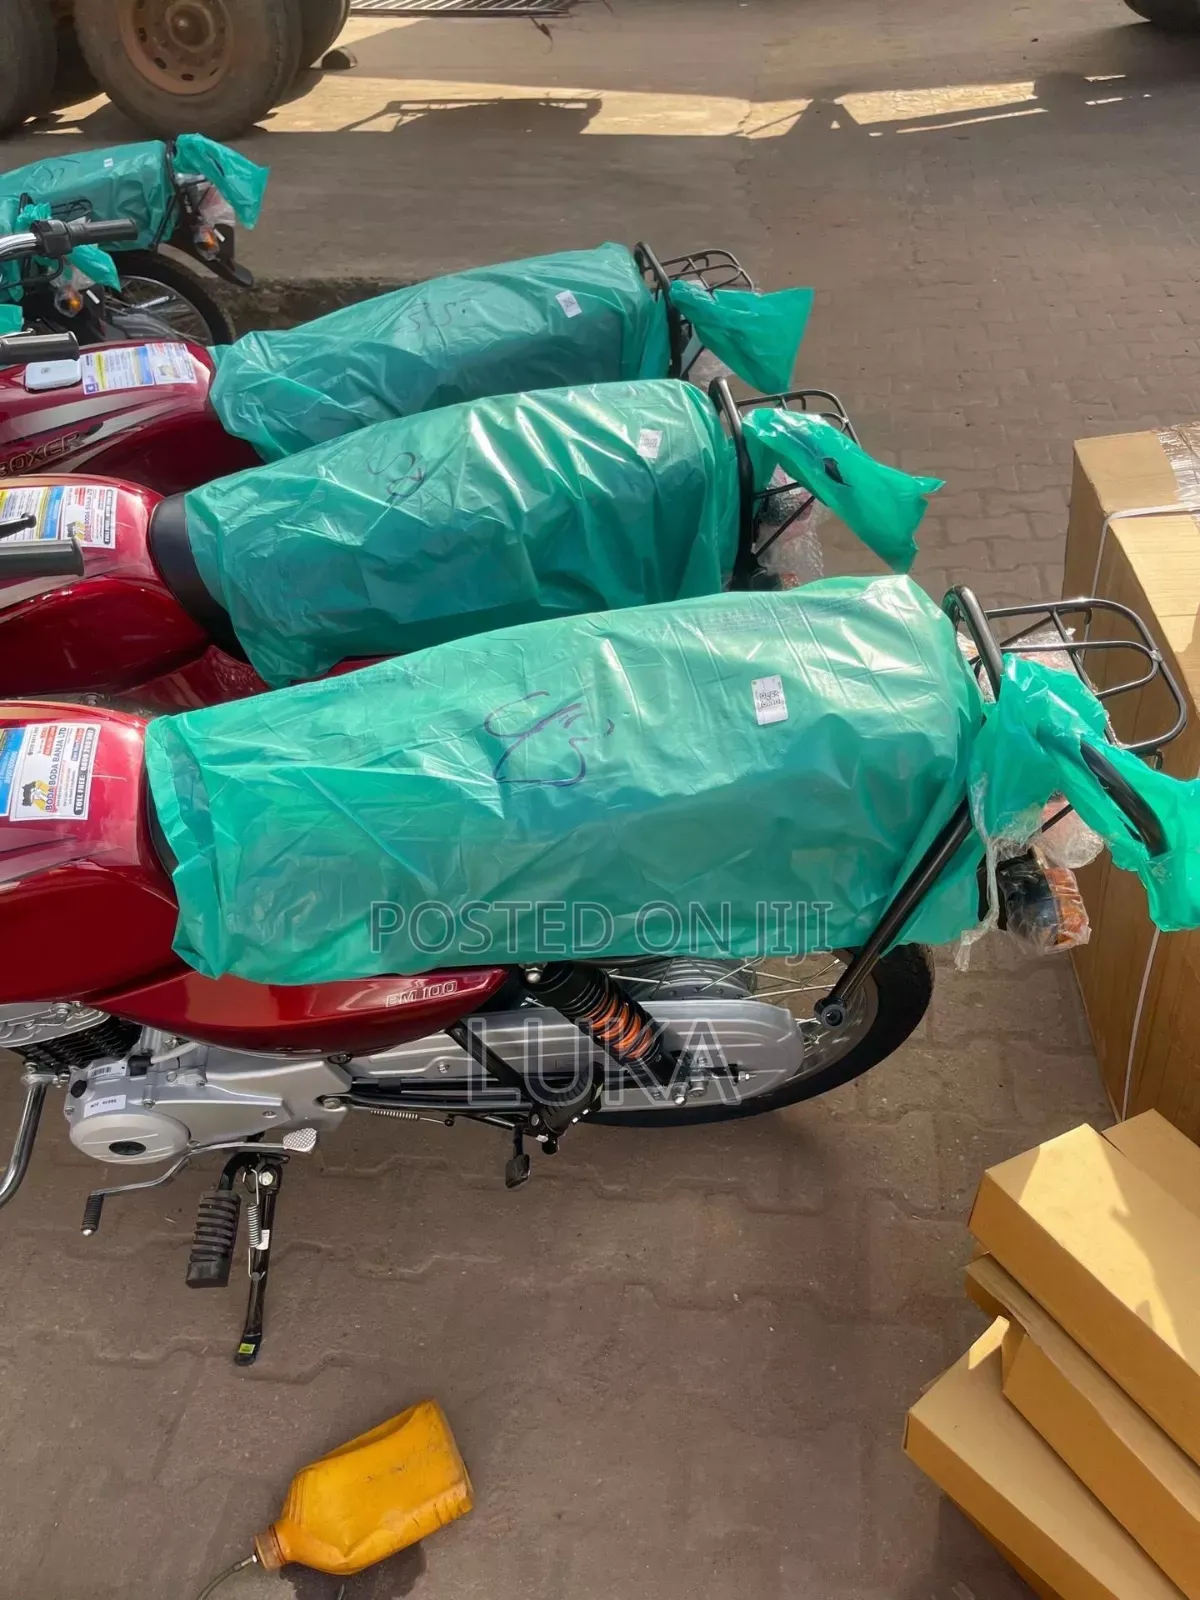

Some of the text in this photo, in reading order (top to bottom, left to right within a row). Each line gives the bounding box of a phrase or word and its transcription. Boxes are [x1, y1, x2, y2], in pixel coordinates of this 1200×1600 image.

[58, 727, 67, 739] LTD
[52, 739, 64, 762] BANJA
[49, 764, 59, 785] BODA
[45, 787, 54, 811] BODA
[75, 793, 84, 811] TOLL
[385, 980, 458, 1008] BM 100
